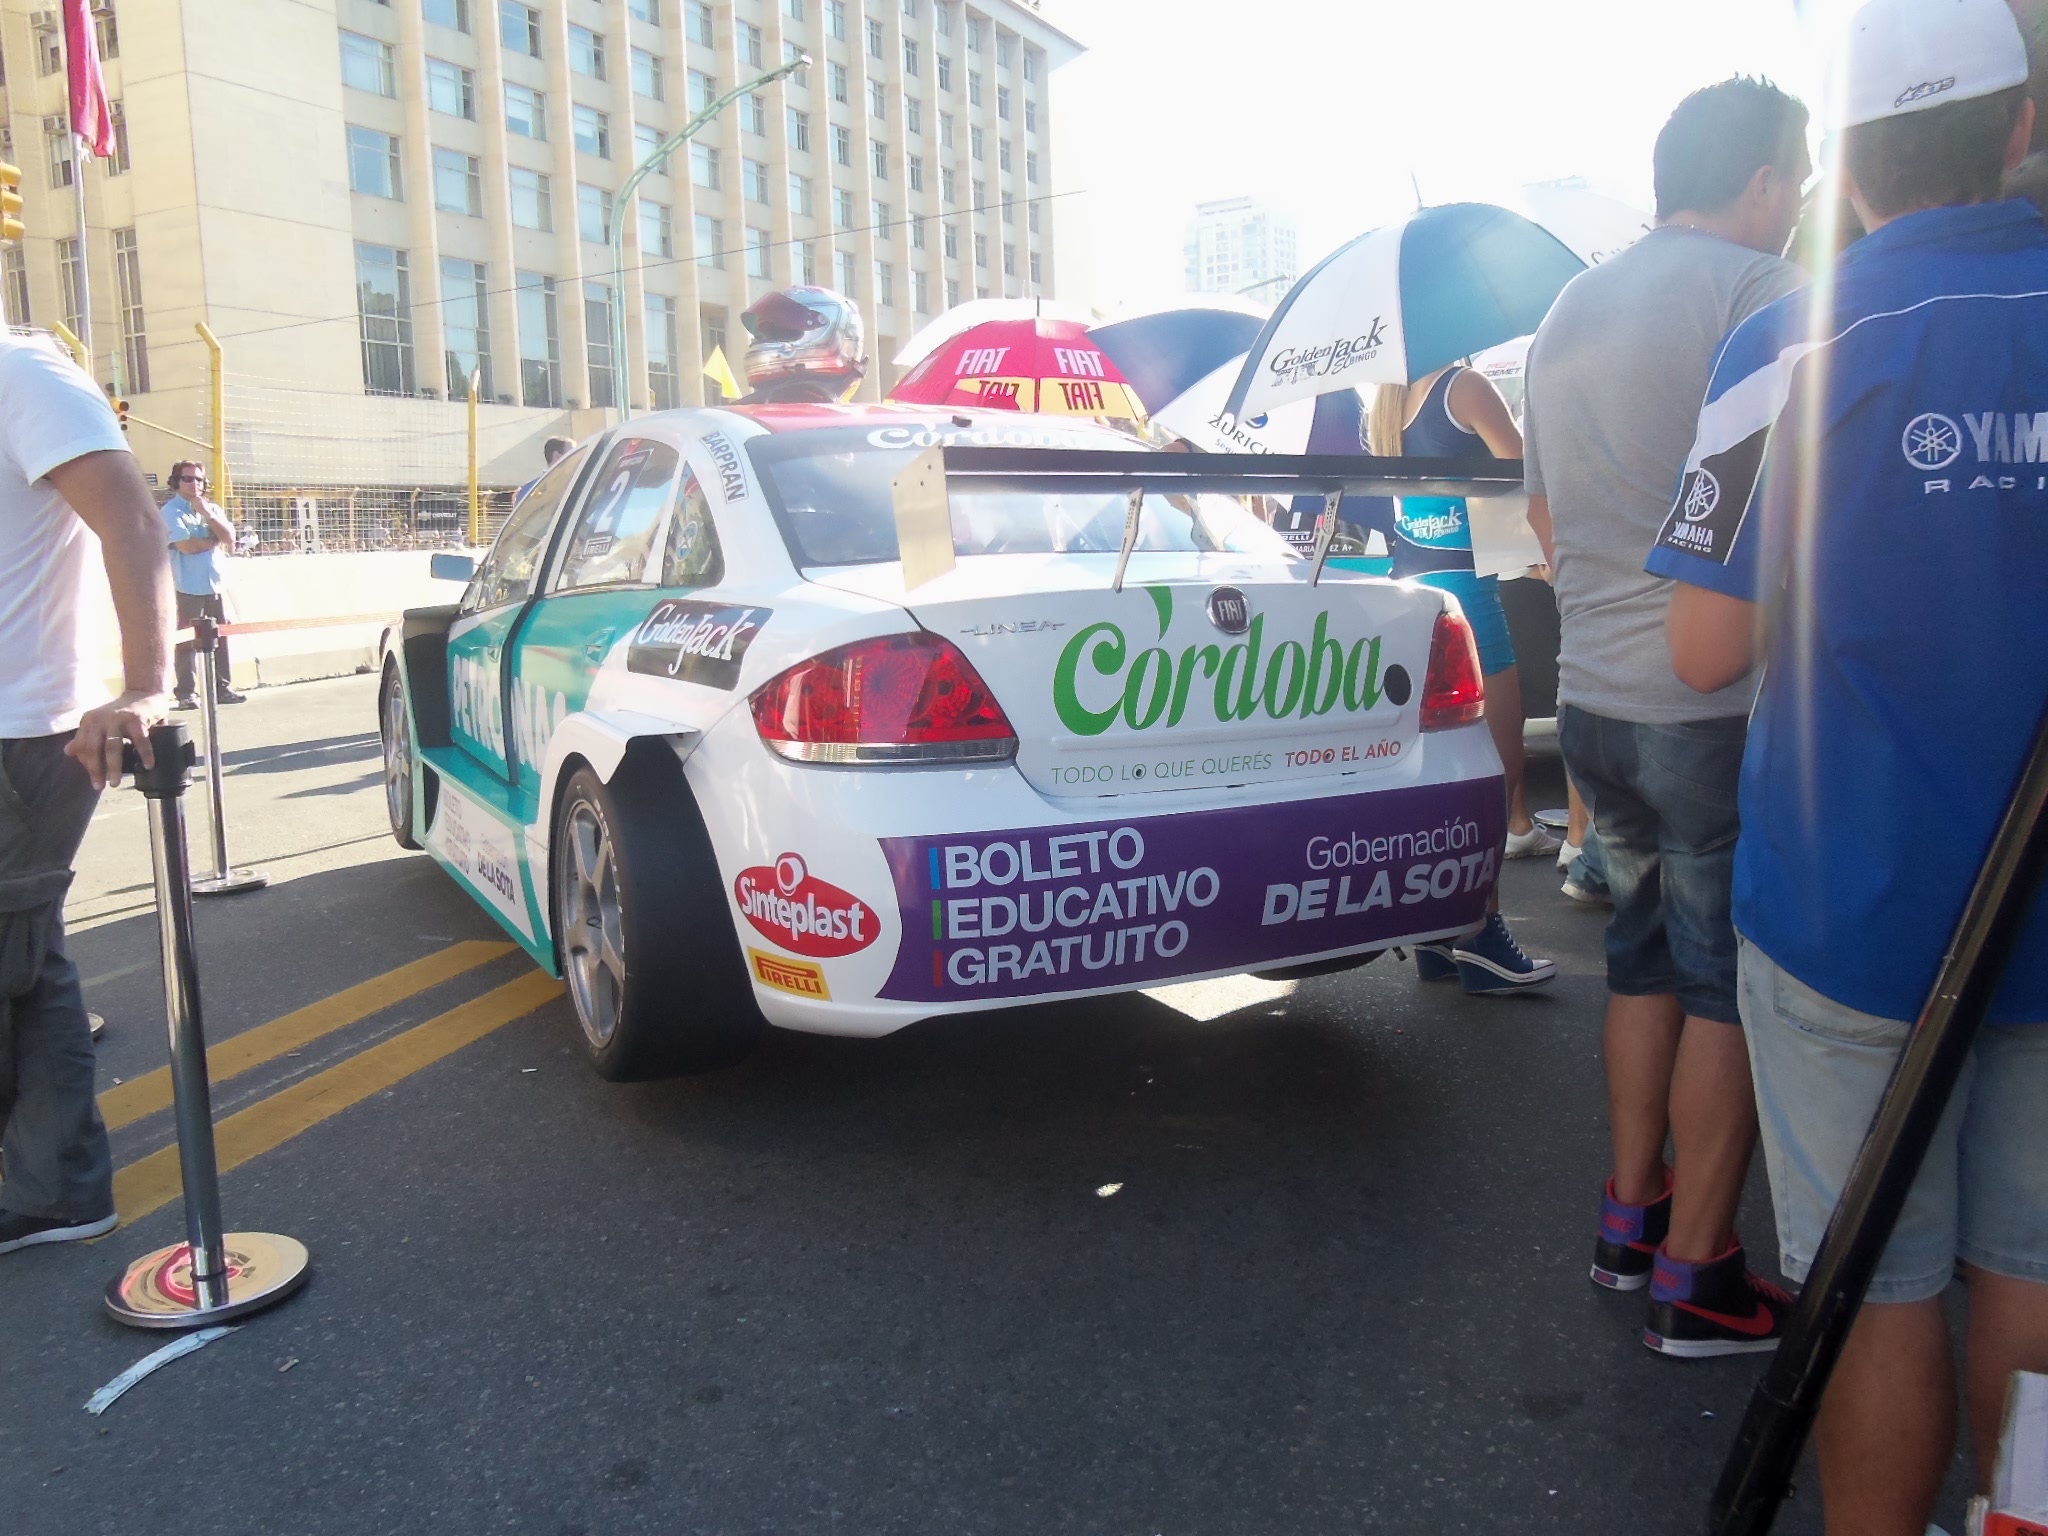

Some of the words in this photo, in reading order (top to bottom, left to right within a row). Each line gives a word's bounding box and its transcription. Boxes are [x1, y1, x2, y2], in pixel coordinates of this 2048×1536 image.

[955, 347, 1011, 376] FIAT
[1053, 347, 1105, 377] FIAT
[1350, 350, 1377, 366] BINGO
[702, 431, 745, 501] BARPRAN
[594, 470, 630, 533] 2
[1675, 521, 1714, 547] YAMAHA
[960, 620, 1065, 637] LINEA
[1216, 598, 1244, 623] FIAT
[1052, 765, 1113, 785] TODO
[1121, 763, 1146, 781] LO
[1154, 759, 1194, 779] QUE
[1201, 750, 1273, 775] QUERÉS
[1285, 747, 1336, 768] TODO
[1341, 745, 1361, 763] EL
[1365, 738, 1402, 760] AÑO
[944, 826, 1145, 891] BOLETO
[1307, 817, 1479, 871] Gobernación
[740, 876, 865, 943] Sinteplast
[947, 866, 1220, 940] EDUCATIVO
[1261, 881, 1330, 927] DE
[1333, 869, 1392, 918] LA
[1399, 851, 1497, 906] SOTA
[755, 955, 823, 994] PIRELLI
[947, 919, 1189, 988] GRATUITO
